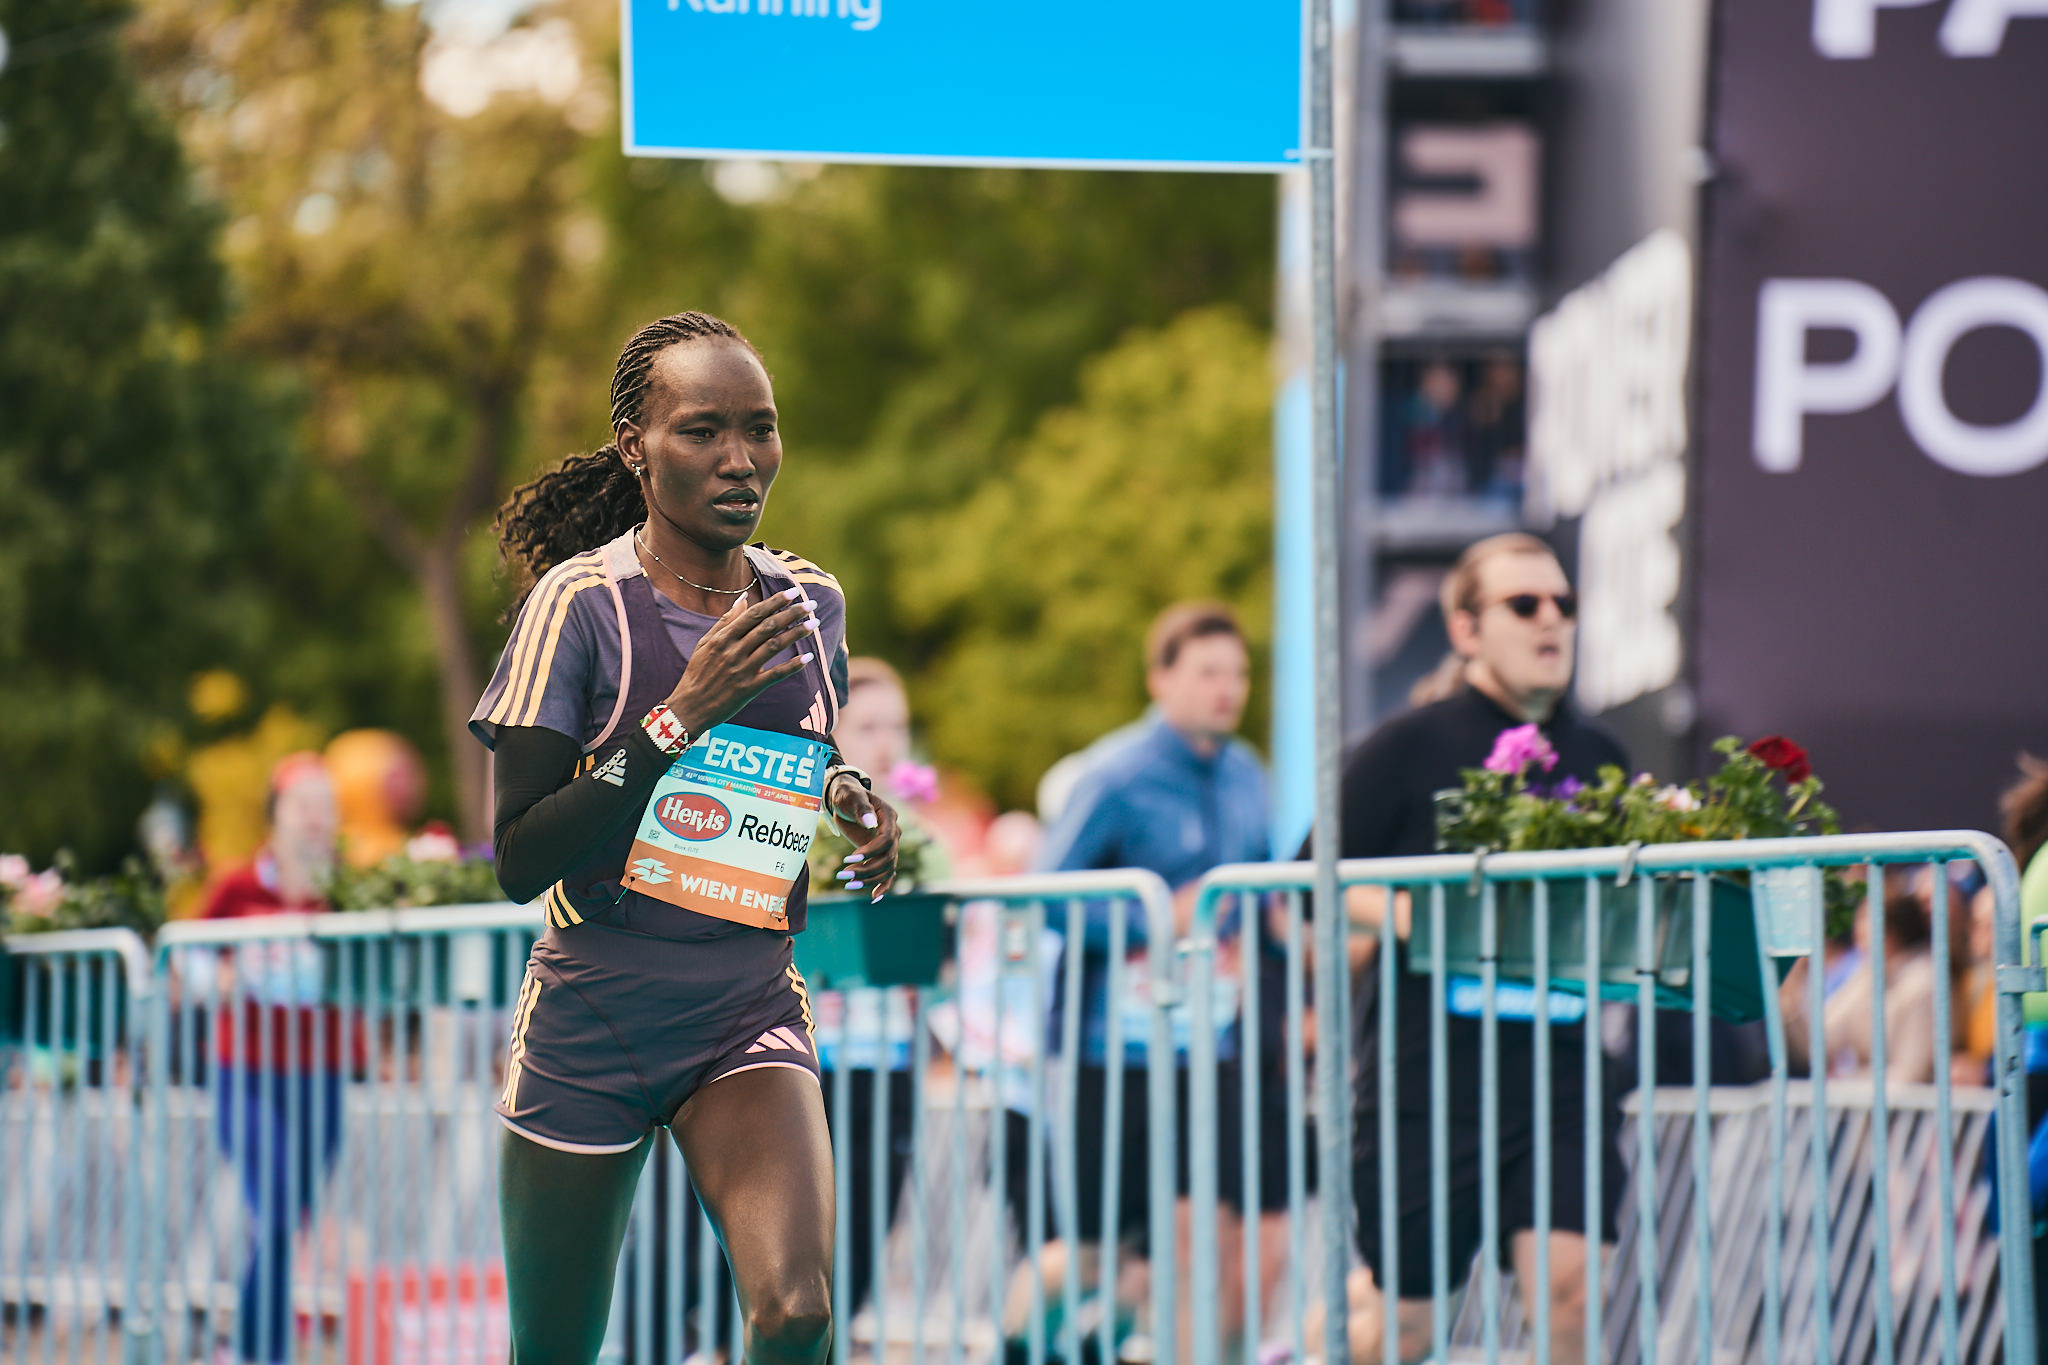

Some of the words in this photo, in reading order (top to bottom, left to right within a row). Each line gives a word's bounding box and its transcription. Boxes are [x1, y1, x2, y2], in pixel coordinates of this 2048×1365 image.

[1752, 274, 2048, 477] PO
[661, 796, 726, 832] Hervis
[737, 813, 810, 853] Rebbeca
[774, 861, 785, 873] F6
[680, 873, 738, 903] WIEN
